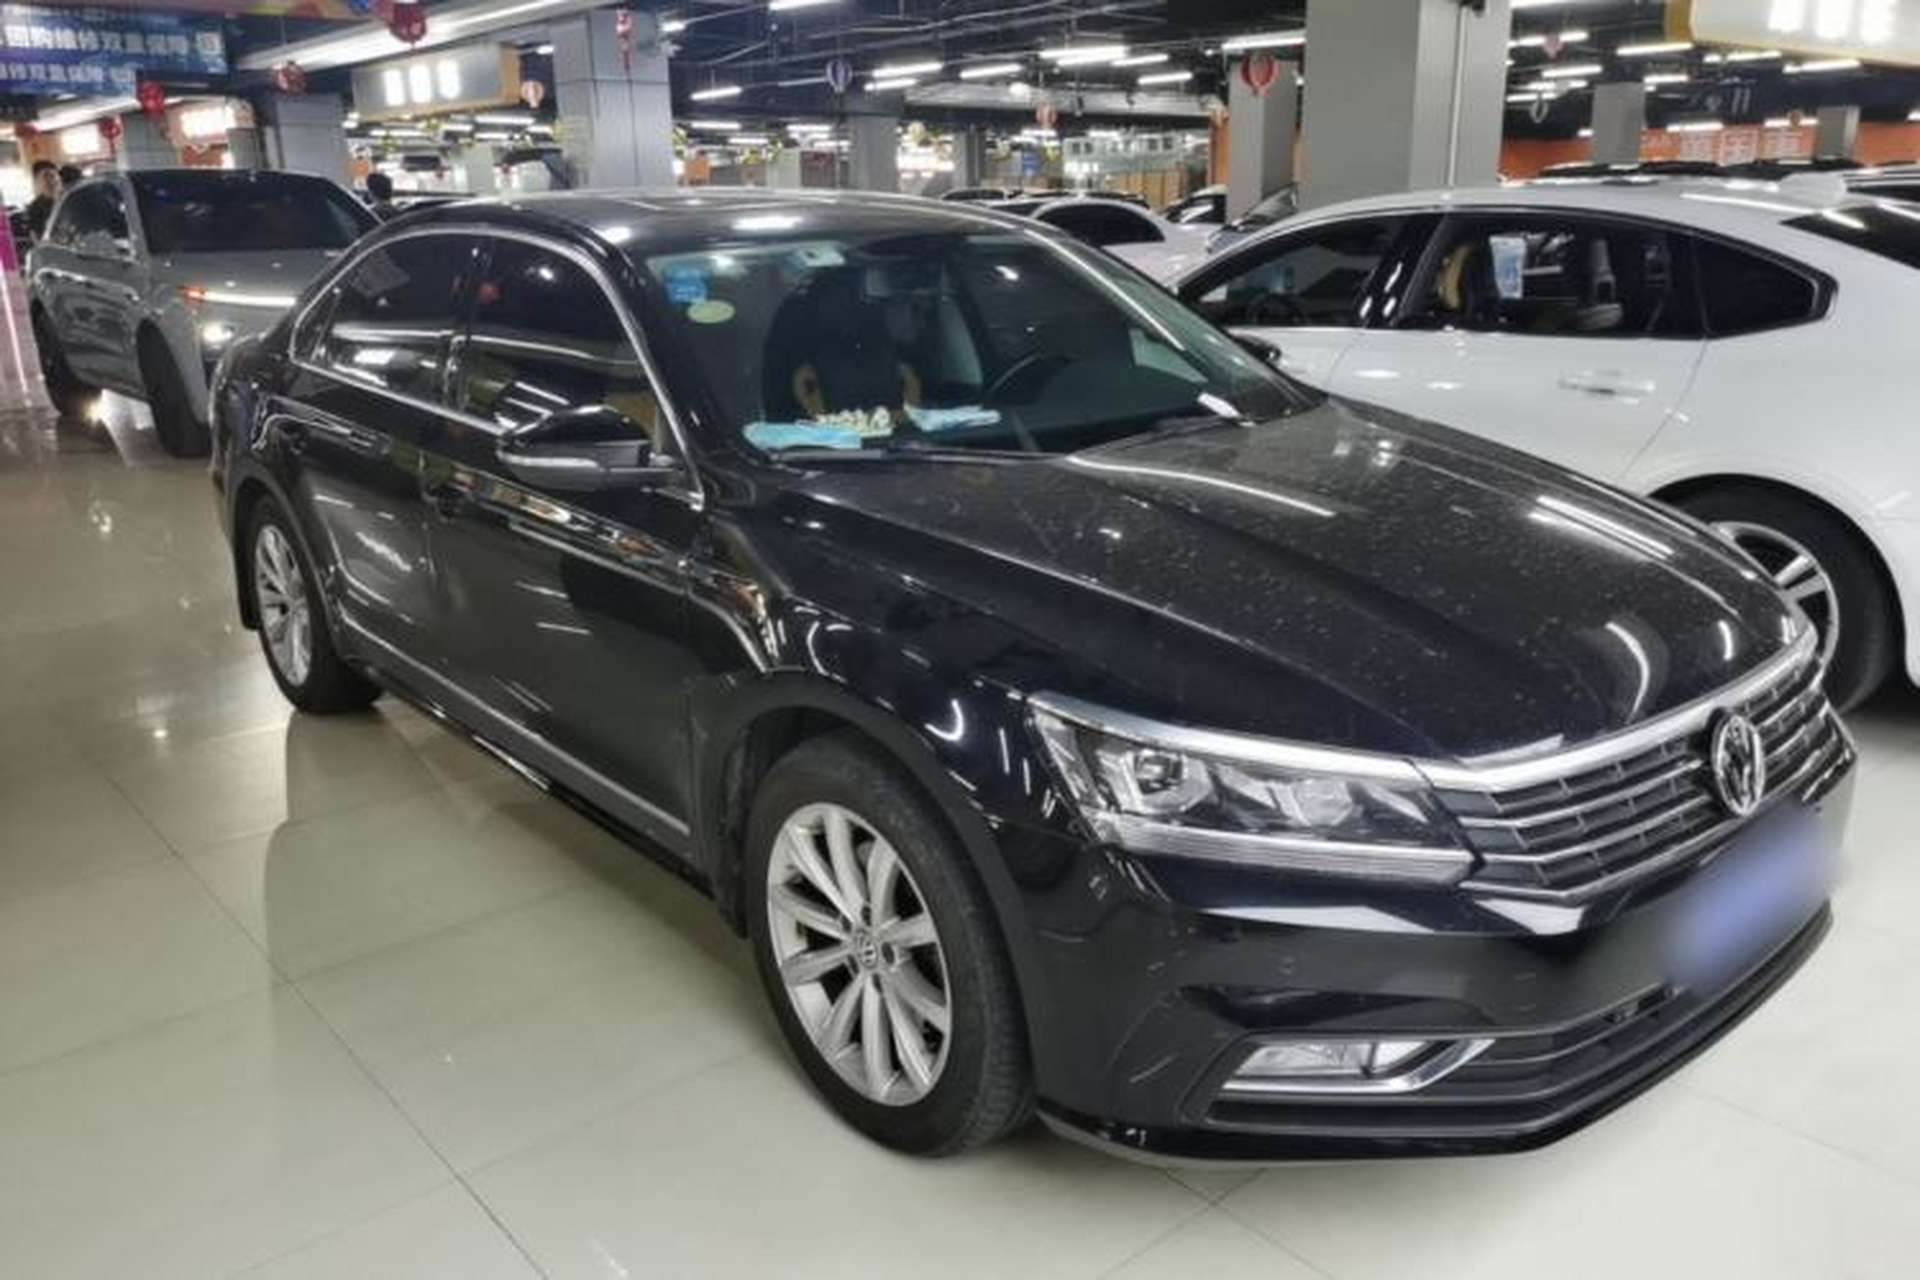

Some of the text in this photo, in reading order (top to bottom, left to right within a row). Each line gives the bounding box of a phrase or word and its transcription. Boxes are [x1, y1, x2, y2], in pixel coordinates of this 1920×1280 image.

[0, 24, 190, 55] 团购维修双重保障
